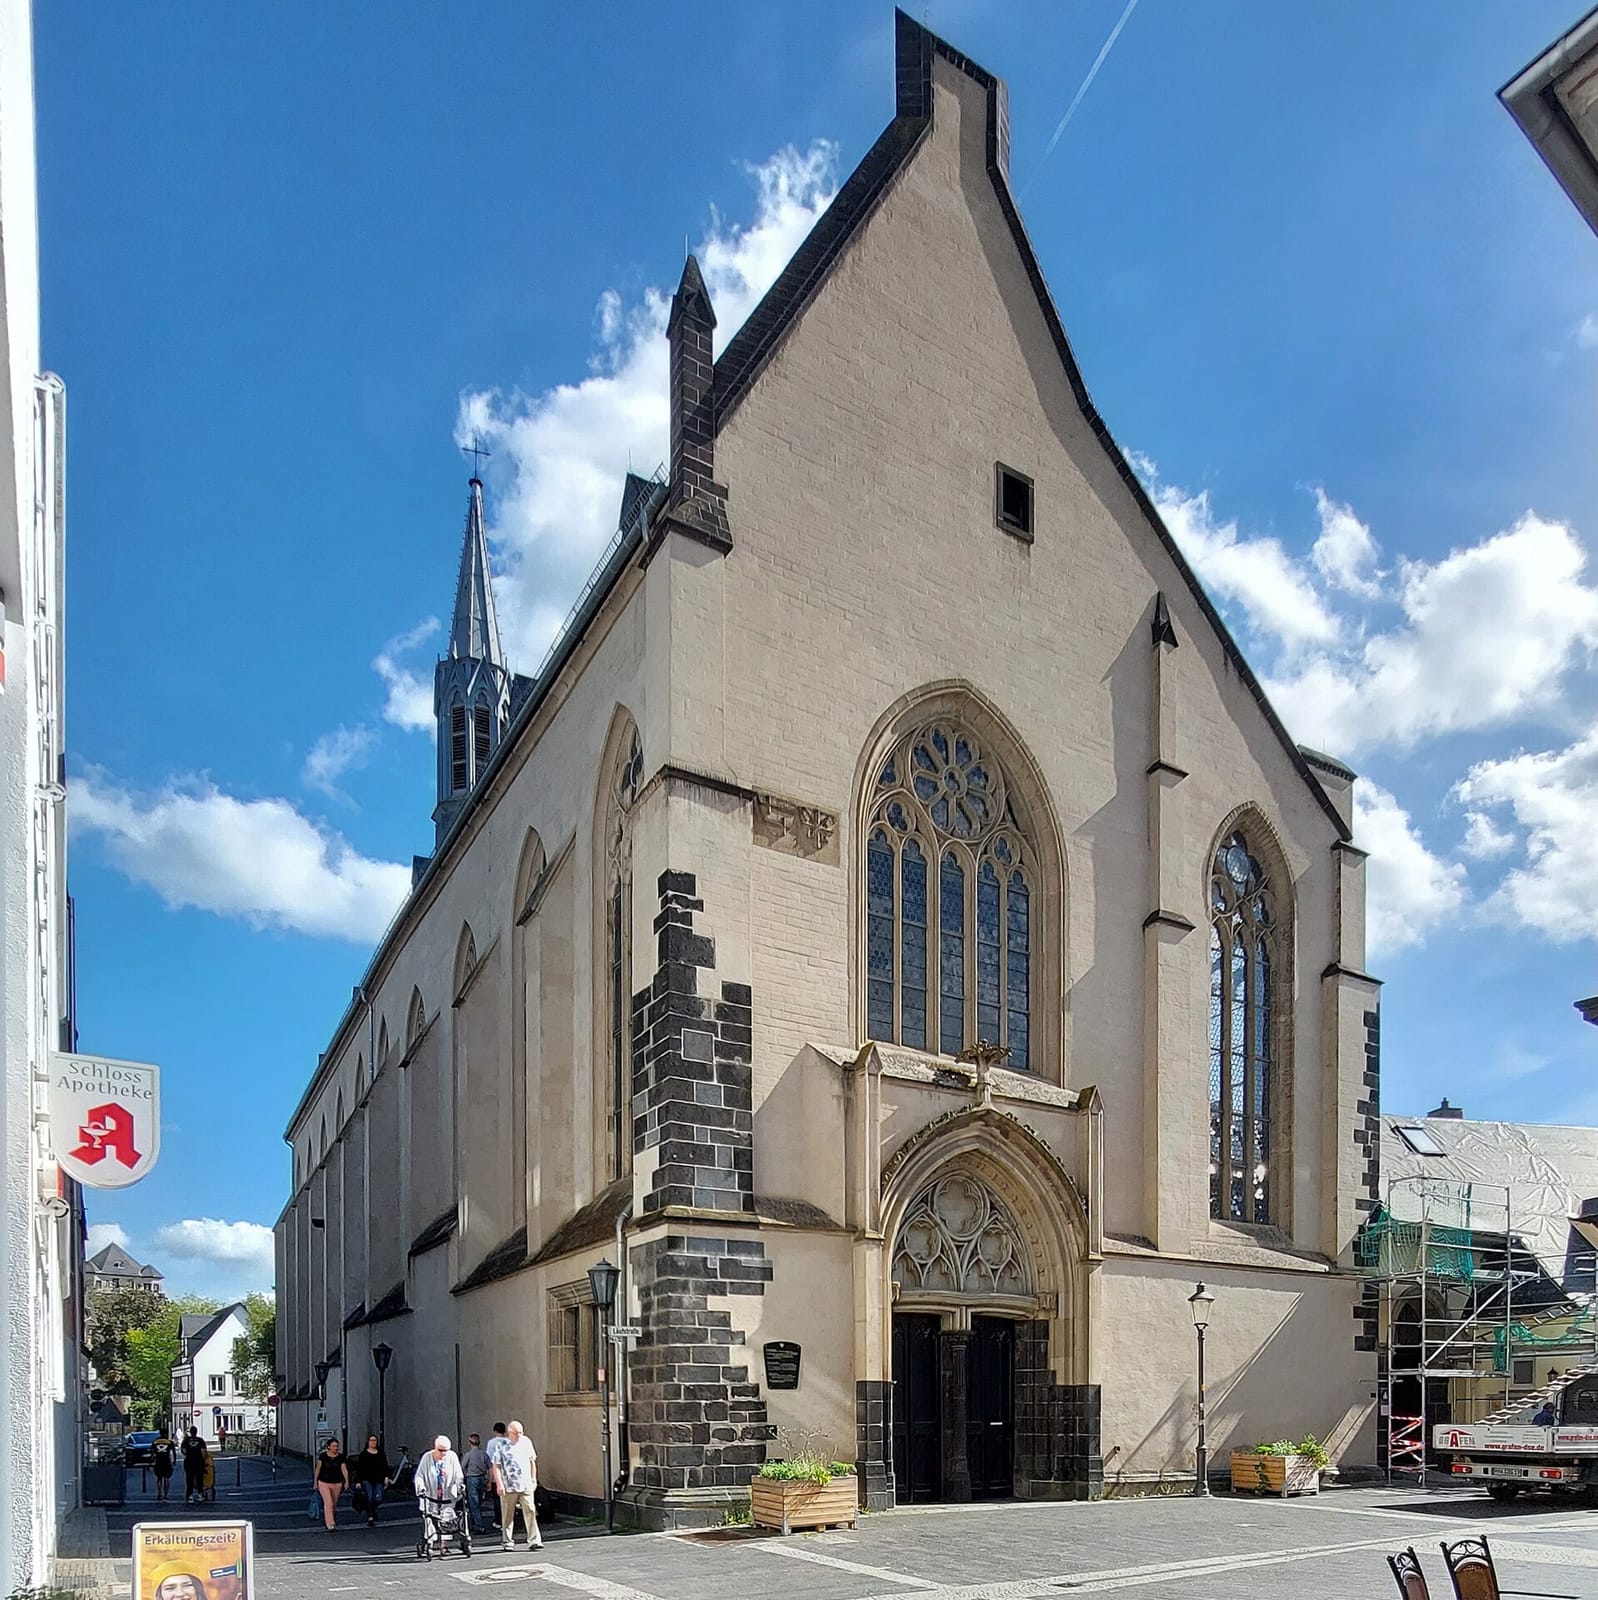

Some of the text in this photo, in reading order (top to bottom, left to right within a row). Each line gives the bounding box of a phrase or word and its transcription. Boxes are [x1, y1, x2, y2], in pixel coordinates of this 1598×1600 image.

[69, 1062, 142, 1083] Schloss
[57, 1076, 153, 1099] Apotheke
[145, 1533, 236, 1546] Erkältungszeit?
